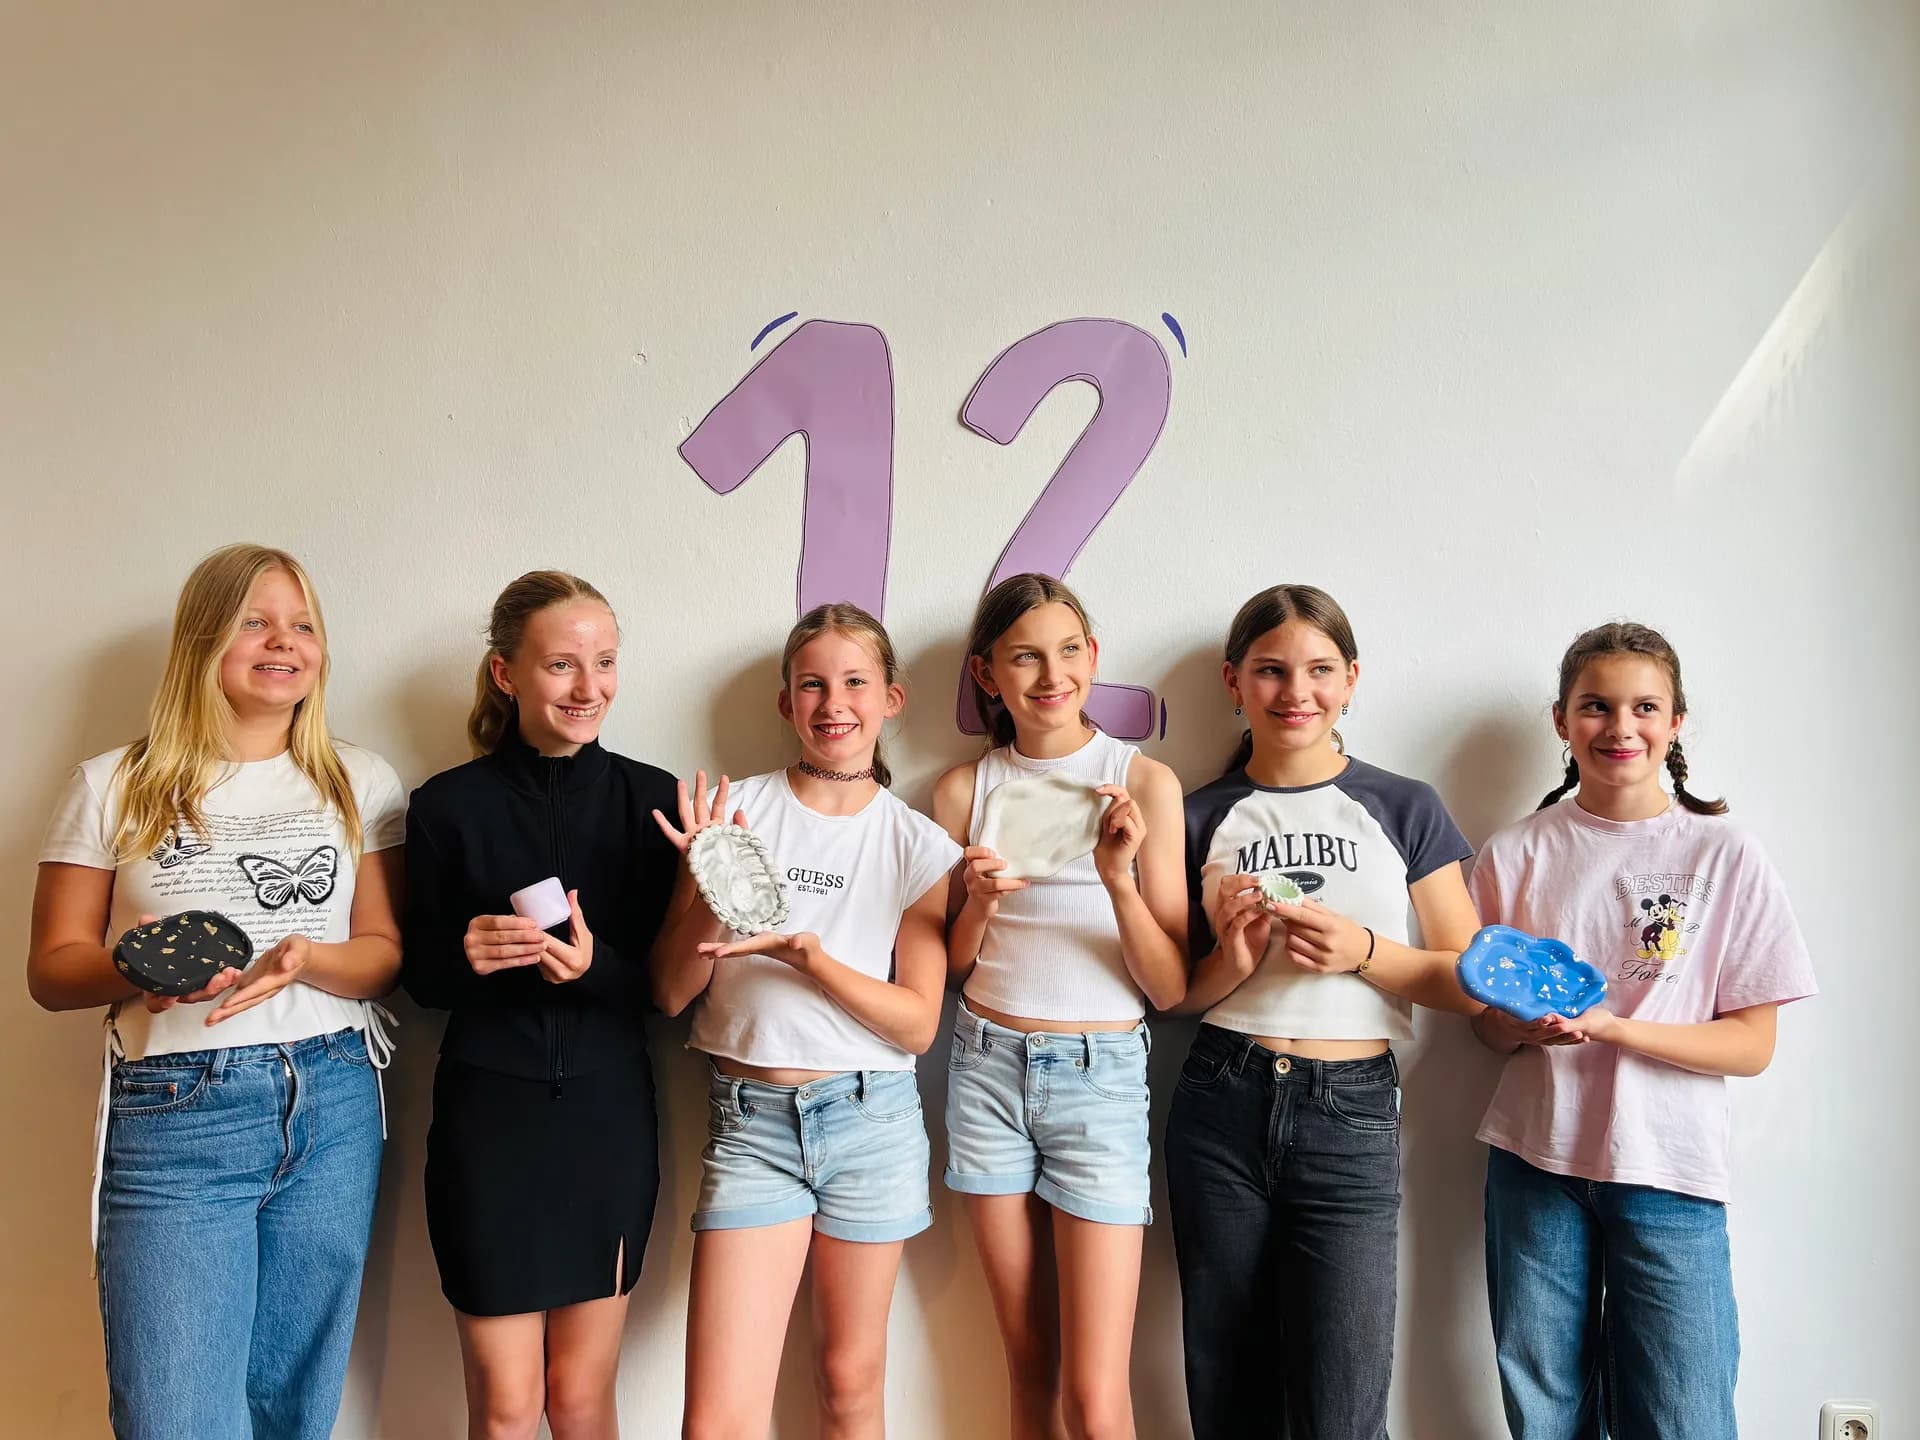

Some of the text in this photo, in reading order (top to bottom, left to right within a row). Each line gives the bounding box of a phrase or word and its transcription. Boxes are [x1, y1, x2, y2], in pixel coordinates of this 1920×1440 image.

[679, 318, 1172, 740] 12
[1236, 833, 1358, 874] MALIBU
[787, 867, 844, 889] GUESS
[798, 884, 828, 896] EST.1981
[1616, 873, 1716, 905] BESTIES
